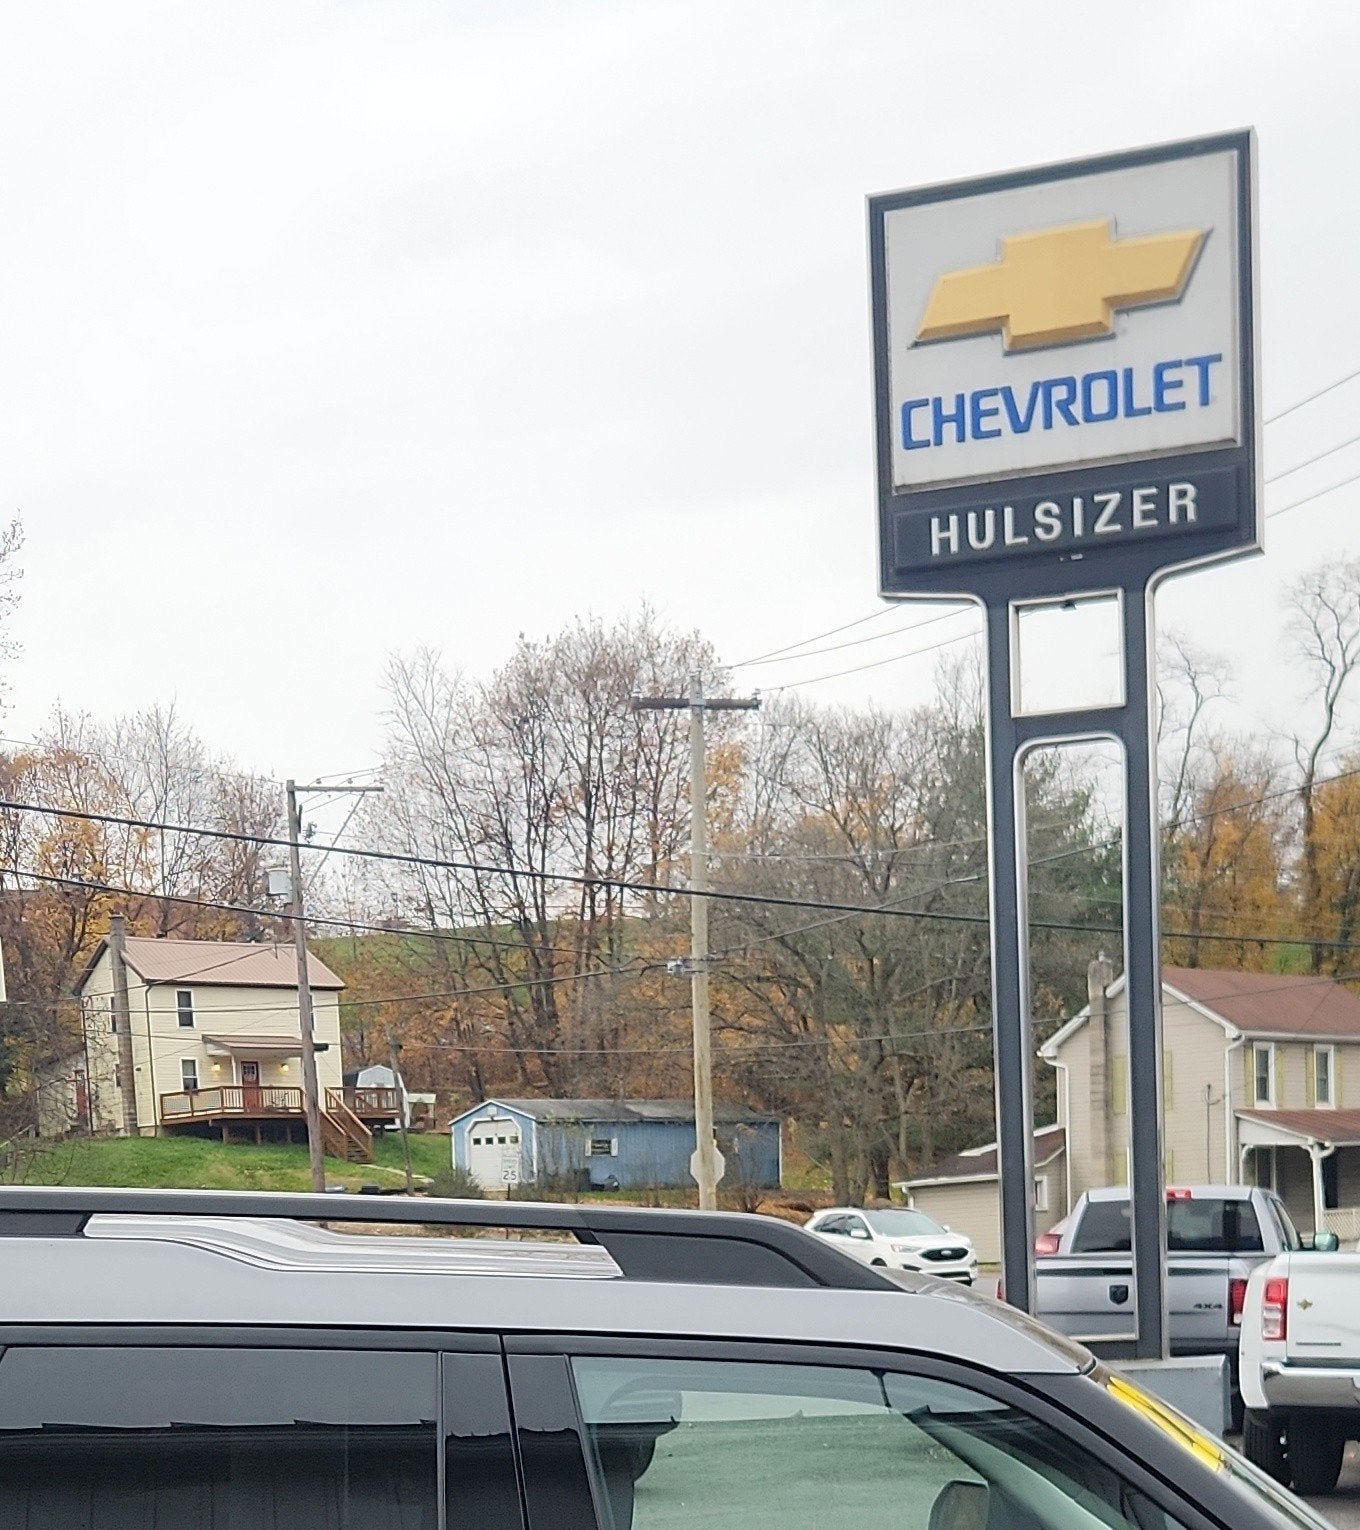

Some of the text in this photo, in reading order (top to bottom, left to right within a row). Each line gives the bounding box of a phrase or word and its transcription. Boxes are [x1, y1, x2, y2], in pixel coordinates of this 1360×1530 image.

[901, 353, 1222, 450] CHEVROLET
[931, 482, 1198, 556] HULSIZER
[503, 1170, 517, 1181] 25
